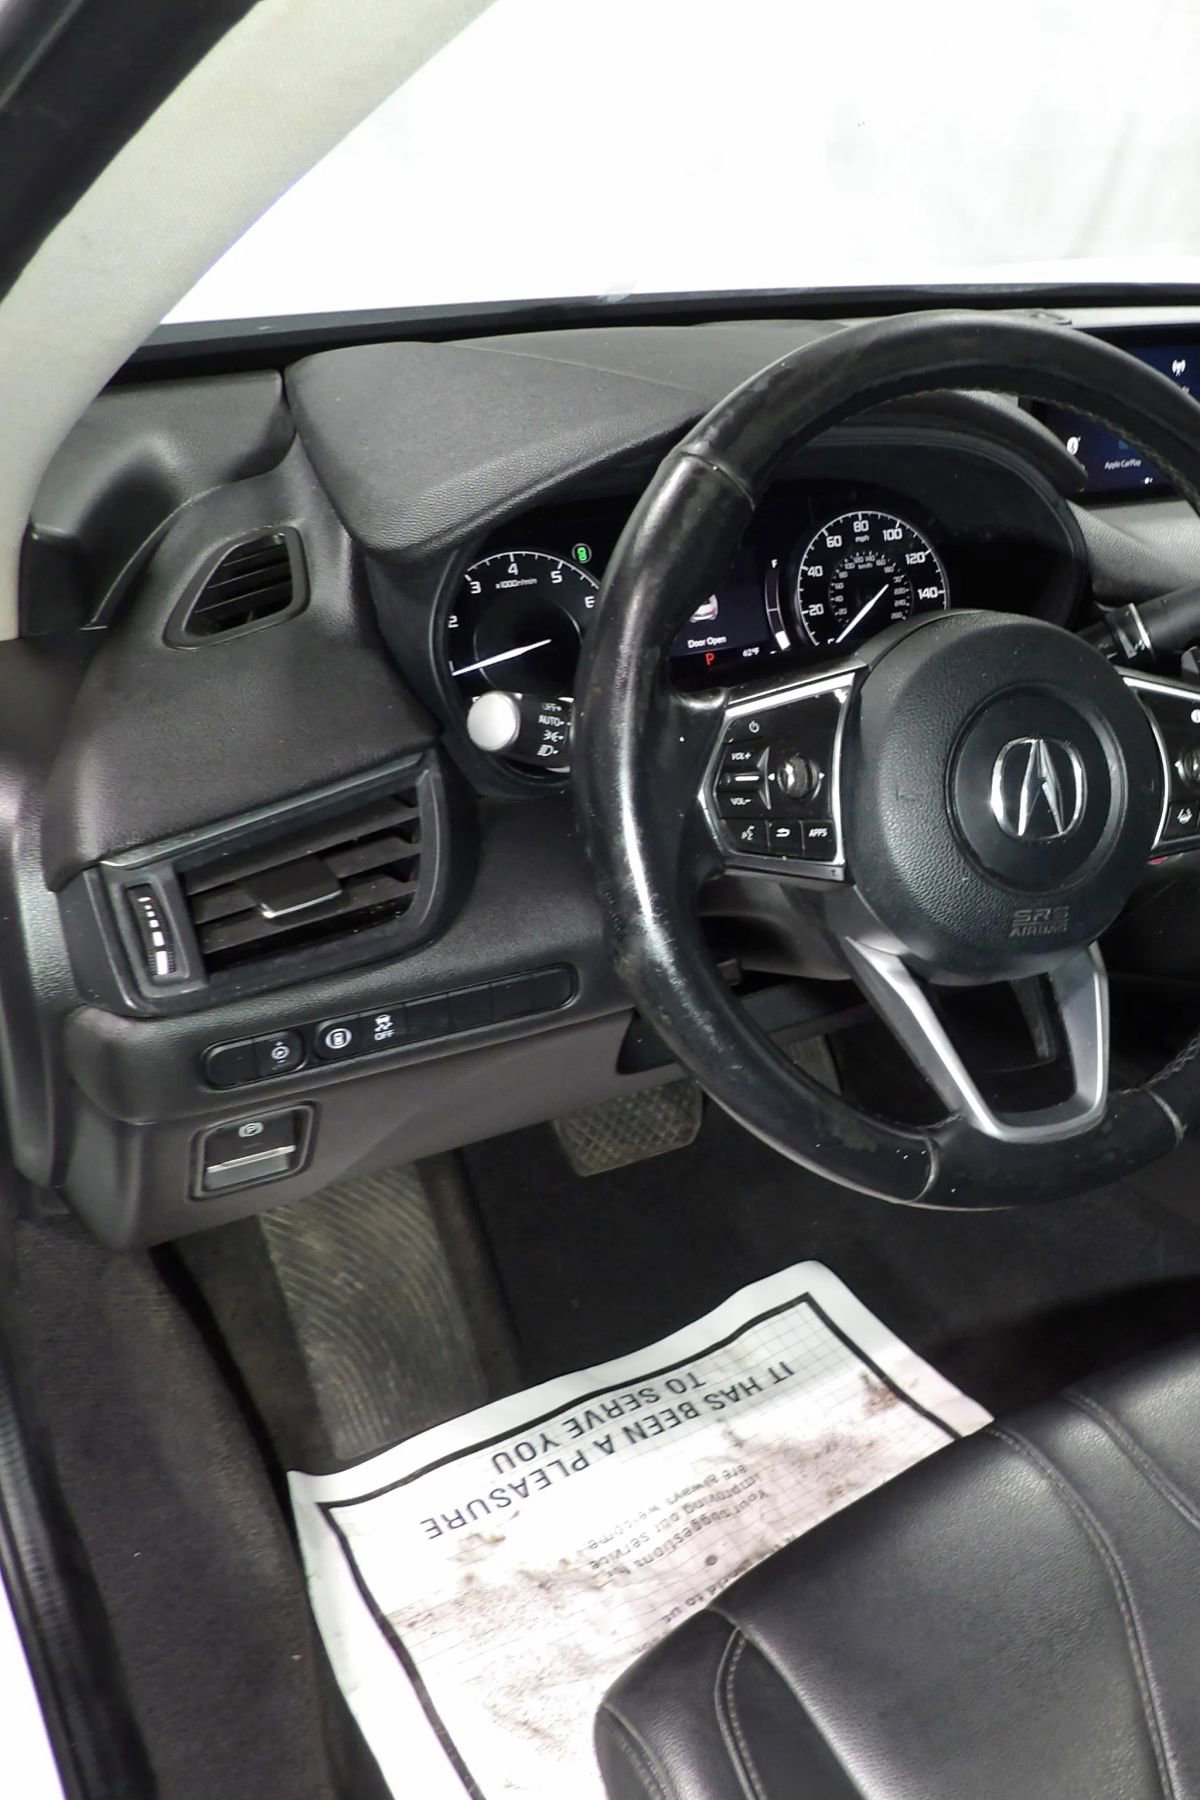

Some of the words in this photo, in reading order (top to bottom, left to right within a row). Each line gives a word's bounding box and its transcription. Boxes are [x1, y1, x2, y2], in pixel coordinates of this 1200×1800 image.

[1104, 461, 1120, 470] Apple
[853, 520, 869, 533] 80
[826, 535, 842, 548] 60
[882, 528, 903, 541] 100
[905, 552, 926, 565] 120
[508, 563, 518, 575] 4
[807, 565, 823, 577] 40
[551, 571, 562, 584] 5
[471, 580, 482, 594] 3
[917, 586, 939, 600] 140
[808, 603, 824, 617] 20
[448, 615, 459, 628] 2
[687, 639, 706, 649] Door
[706, 636, 728, 646] Open
[705, 652, 715, 666] P
[539, 714, 561, 727] AUTO
[374, 1029, 396, 1041] OFF
[768, 1361, 795, 1385] IT
[664, 1371, 707, 1395] TO
[703, 1376, 764, 1411] HAS
[561, 1387, 661, 1439] SERVE
[621, 1401, 700, 1445] BEEN
[592, 1433, 616, 1456] A
[491, 1432, 561, 1475] YOU
[419, 1449, 591, 1540] PLEASURE
[736, 1488, 771, 1515] Your
[589, 1531, 651, 1570] service
